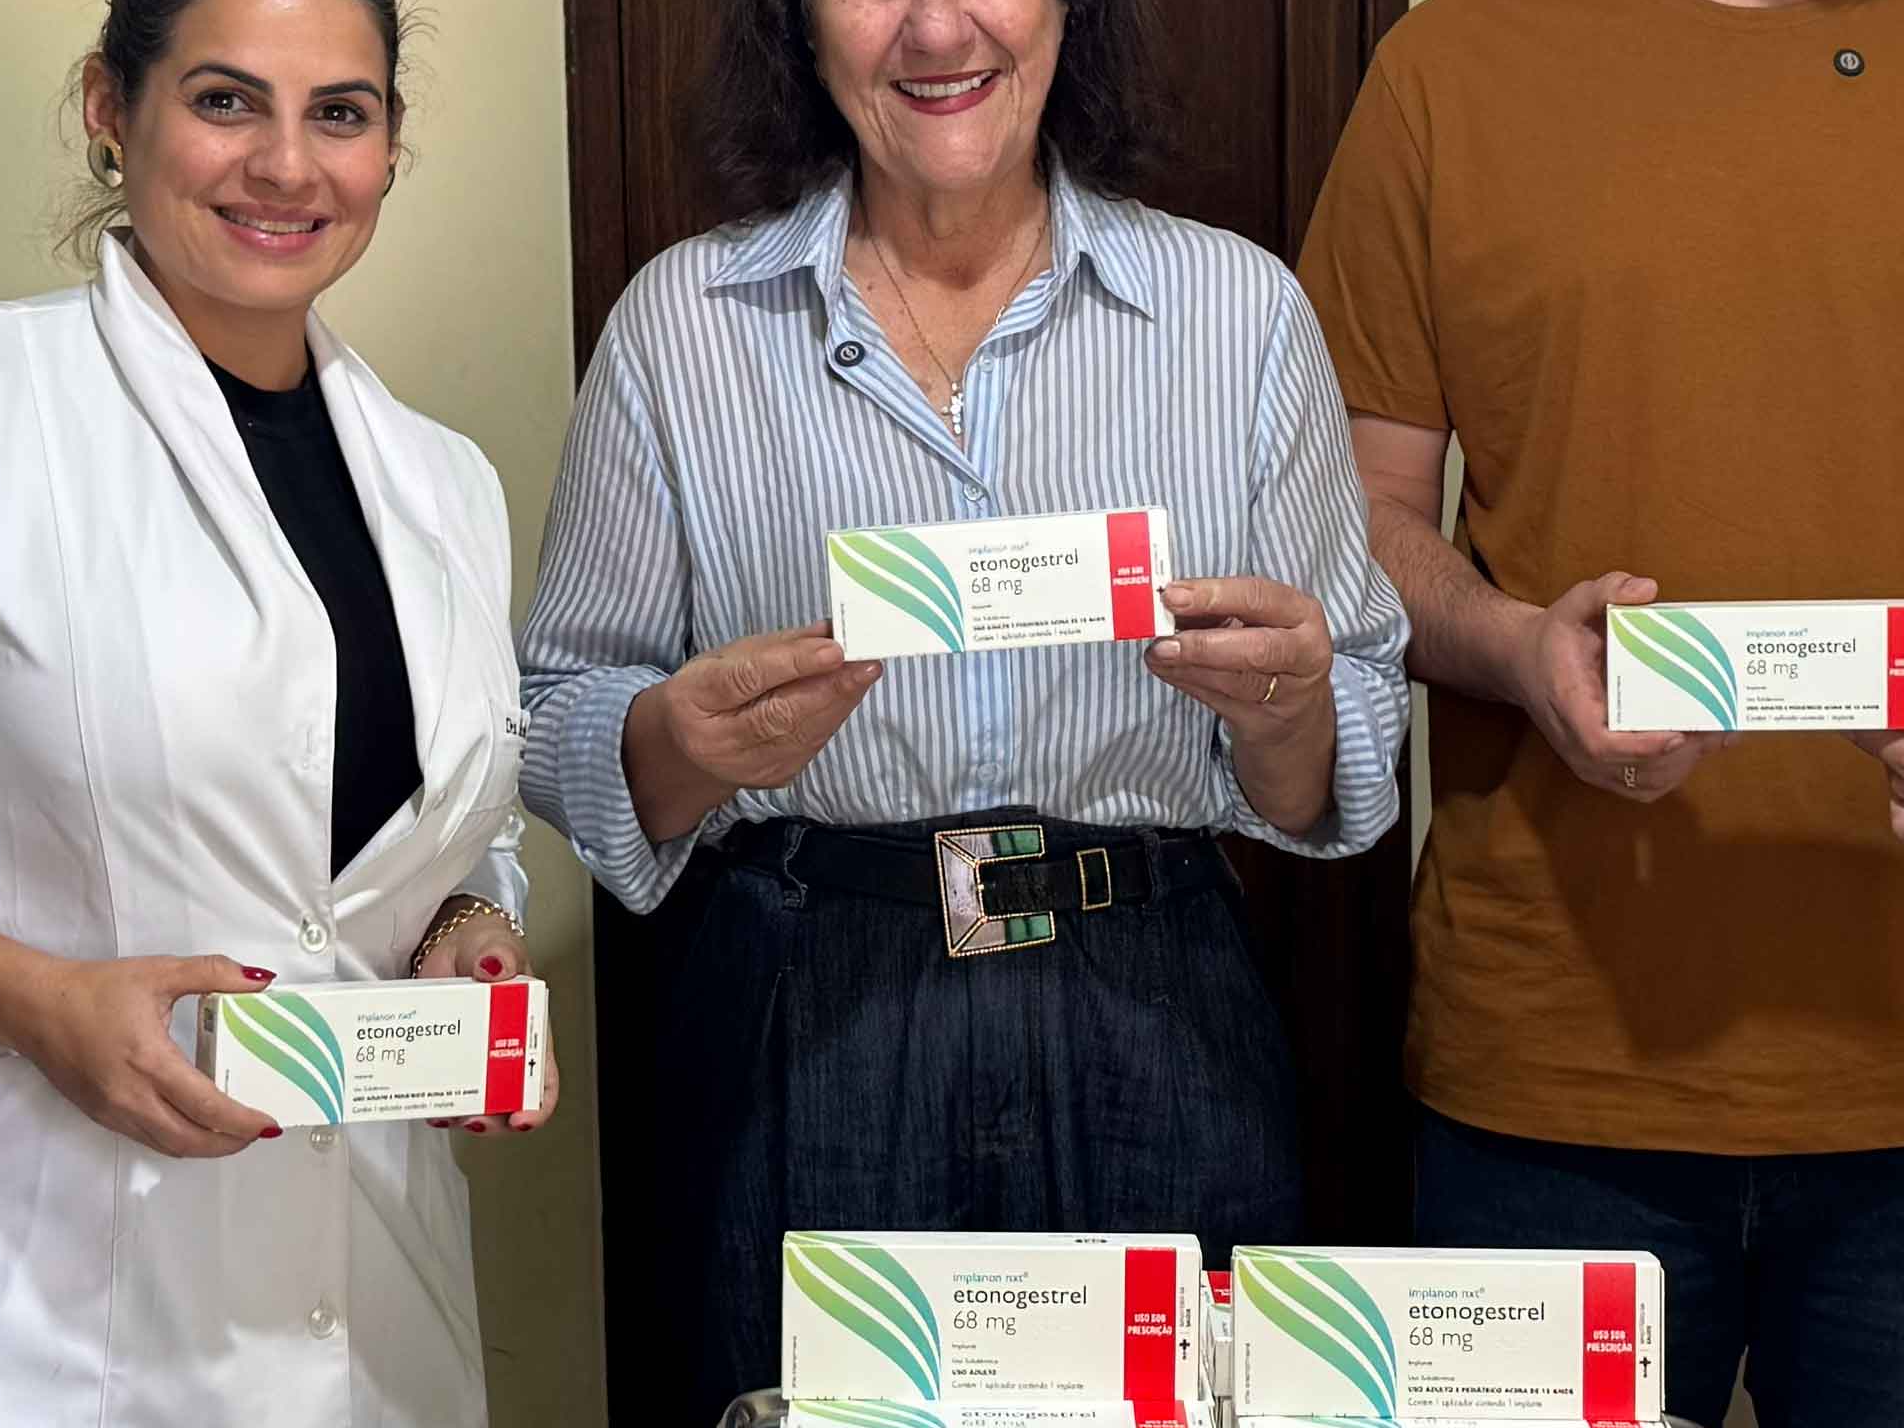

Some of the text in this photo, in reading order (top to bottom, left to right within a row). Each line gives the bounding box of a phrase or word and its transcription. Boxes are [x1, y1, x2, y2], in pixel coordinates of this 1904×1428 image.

[970, 548, 1078, 573] etonogestrel
[971, 577, 1023, 595] 68 mg
[1746, 638, 1856, 658] etonogestrel
[1746, 660, 1799, 679] 68 mg
[357, 1019, 461, 1042] etonogestrel
[356, 1046, 406, 1065] 68 mg
[953, 1273, 1002, 1284] implanon
[953, 1285, 1087, 1309] etonogestrel
[1409, 1288, 1457, 1300] implanon
[953, 1310, 1017, 1335] 68 mg
[1409, 1301, 1545, 1326] etonogestrel
[1409, 1326, 1473, 1352] 68 mg
